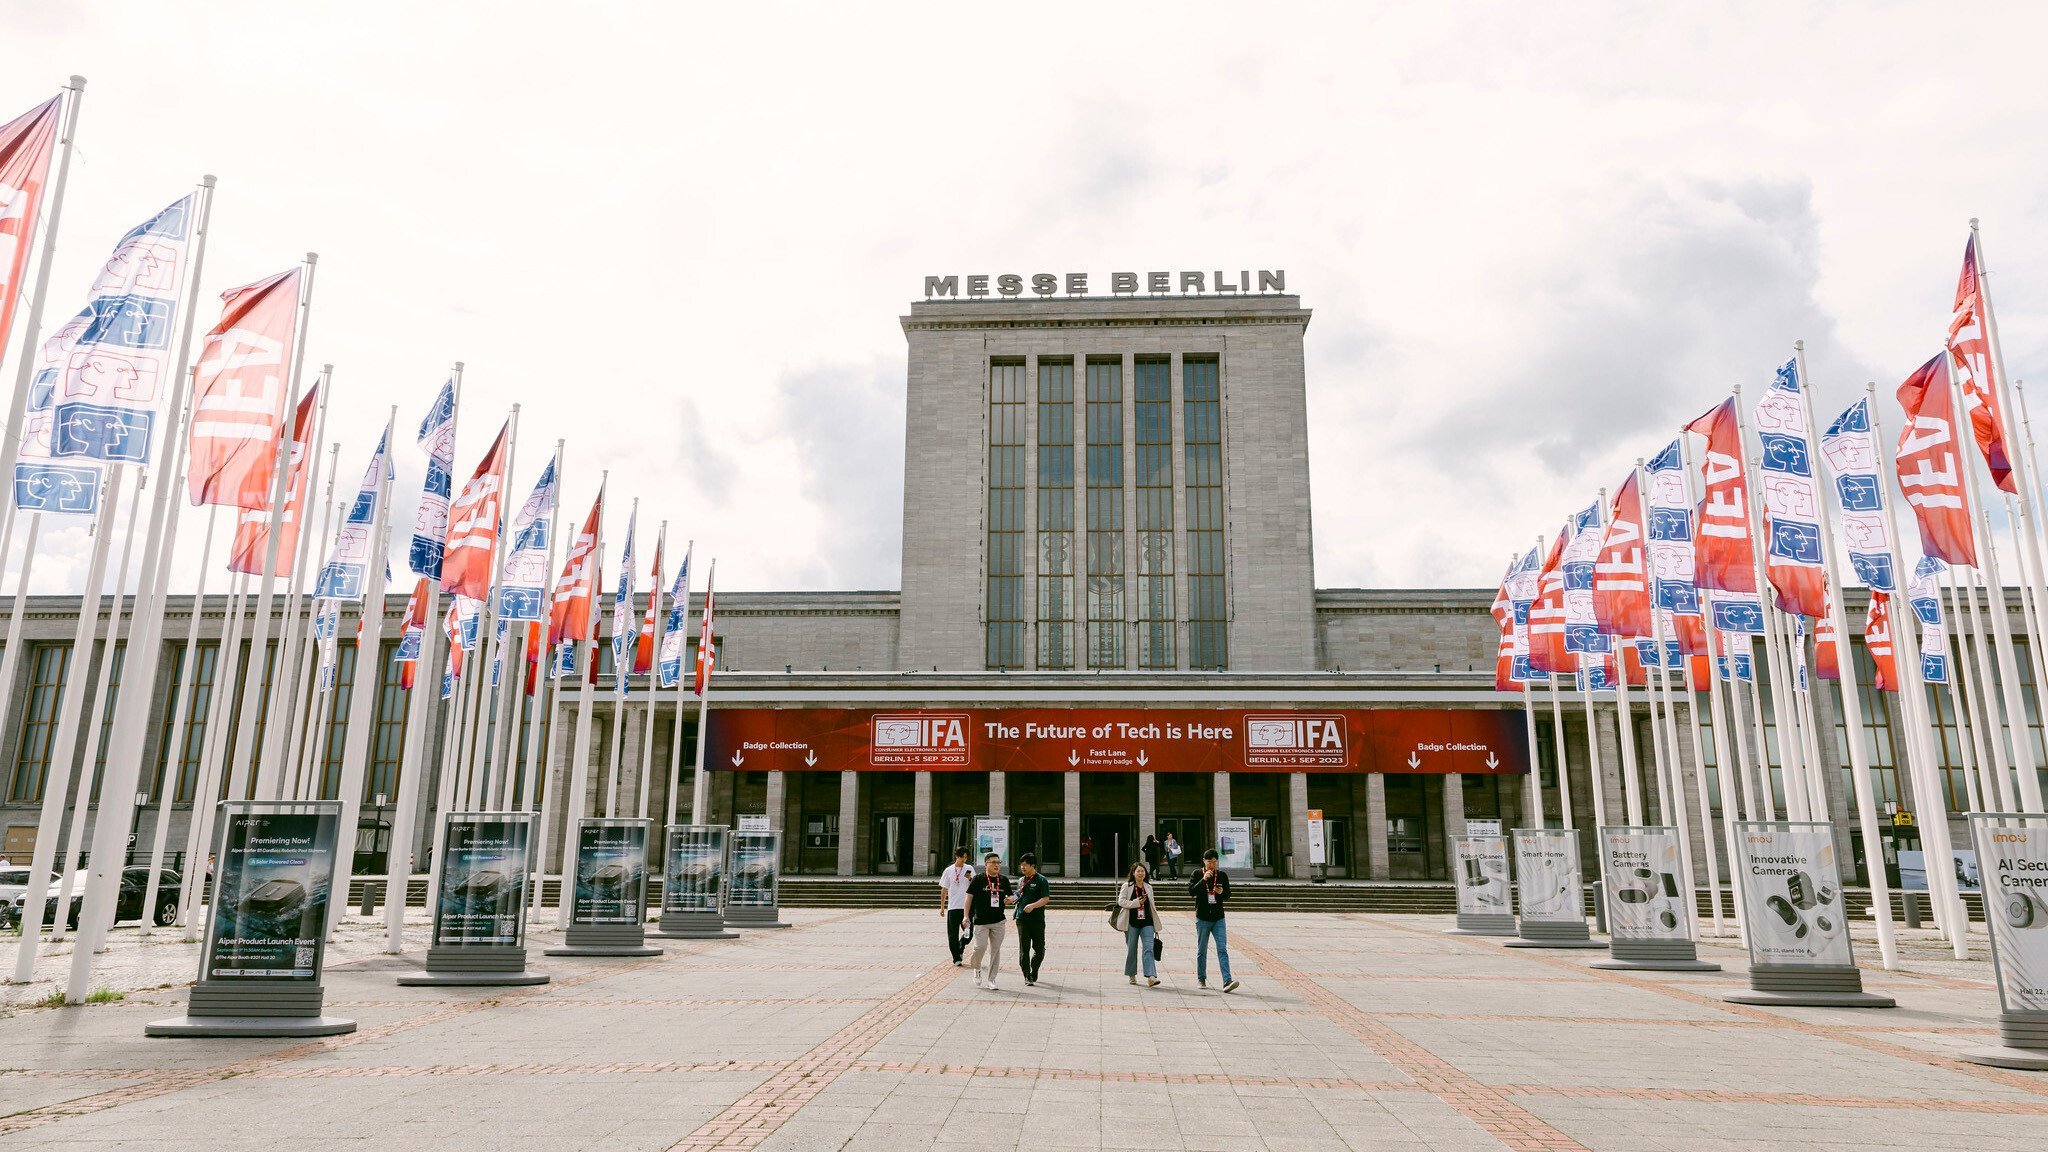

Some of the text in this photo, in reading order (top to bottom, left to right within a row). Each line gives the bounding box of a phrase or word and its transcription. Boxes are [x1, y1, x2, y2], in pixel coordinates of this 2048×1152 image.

[924, 270, 1286, 297] MESSE BERLIN
[922, 720, 965, 747] IFA
[984, 722, 1233, 739] The Future of Tech is Here
[1296, 720, 1342, 748] IFA
[743, 742, 768, 750] Badge
[1417, 743, 1444, 752] Badge
[250, 837, 290, 845] Premiering
[1751, 855, 1807, 864] Innovative
[1998, 858, 2013, 871] AI
[1752, 866, 1799, 876] Cameras
[218, 938, 237, 946] Aiper
